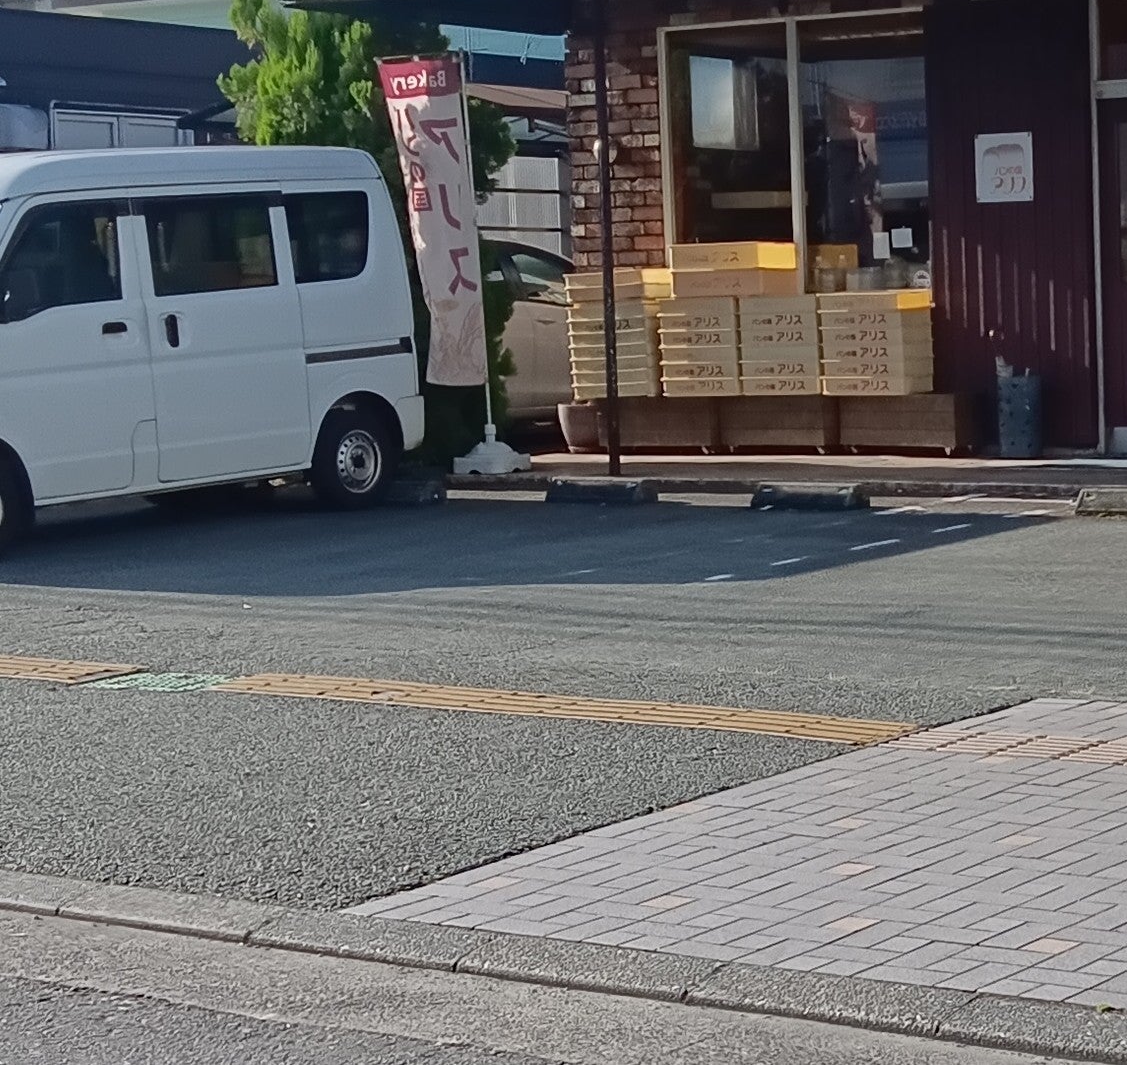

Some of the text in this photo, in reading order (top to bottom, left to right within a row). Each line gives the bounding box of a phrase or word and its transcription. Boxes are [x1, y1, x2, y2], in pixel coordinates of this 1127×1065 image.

[694, 317, 720, 327] アリス
[775, 315, 802, 325] アリス
[859, 314, 886, 324] アリス
[695, 334, 722, 344] アリス
[776, 332, 804, 342] アリス
[860, 331, 887, 341] アリス
[860, 347, 888, 357] アリス
[696, 366, 723, 376] アリス
[777, 364, 805, 374] アリス
[861, 364, 888, 374] アリス
[778, 380, 806, 391] アリス
[861, 380, 889, 391] アリス
